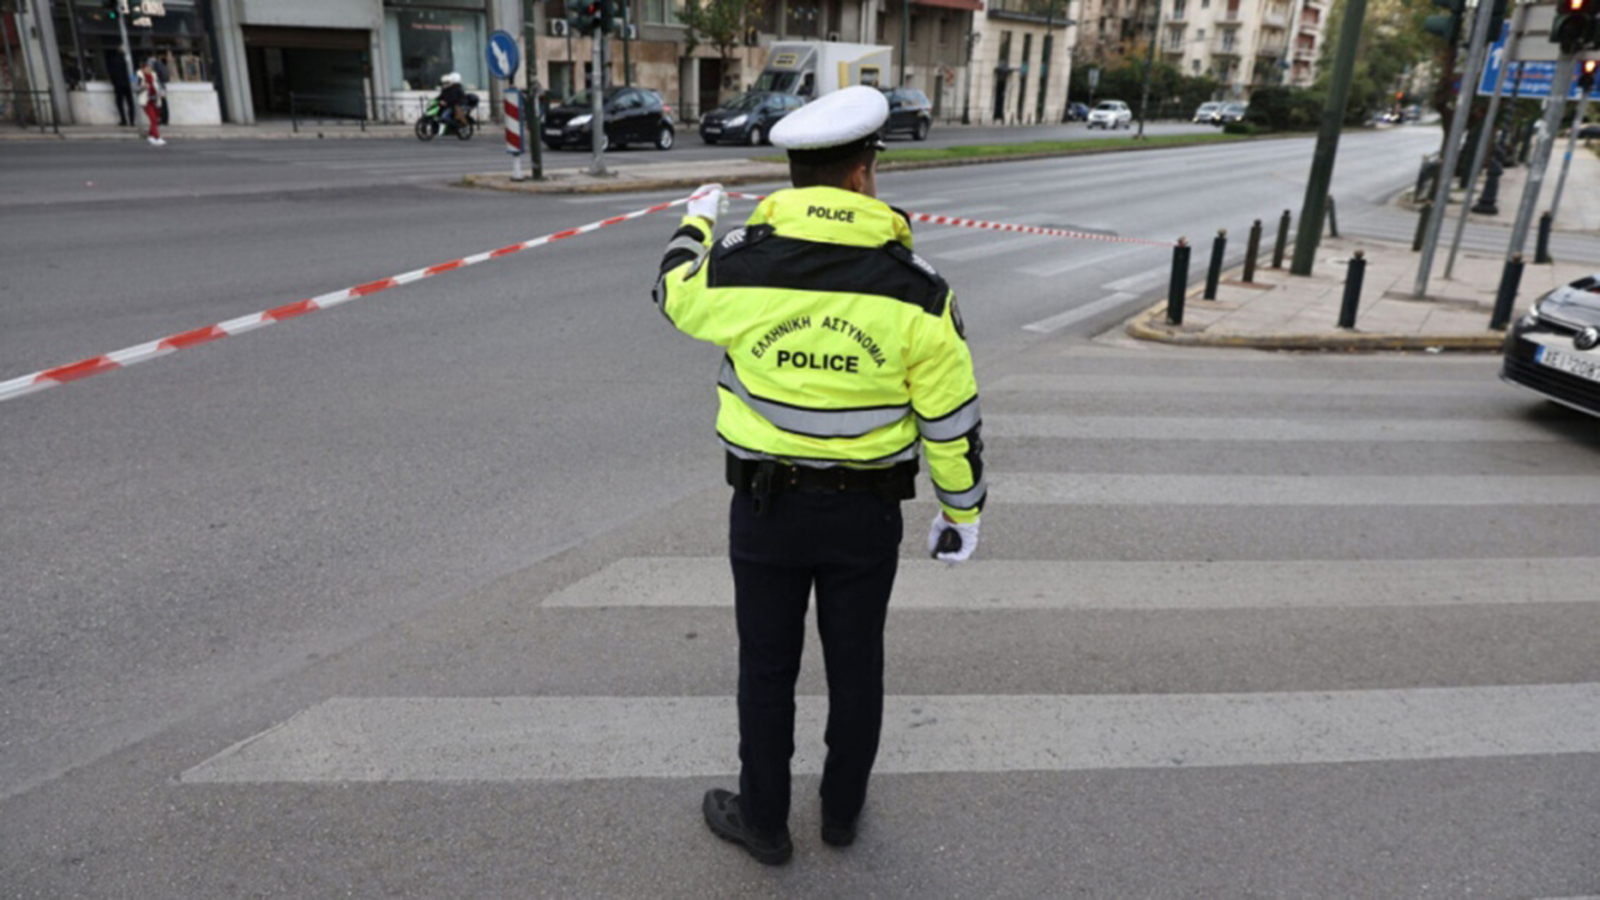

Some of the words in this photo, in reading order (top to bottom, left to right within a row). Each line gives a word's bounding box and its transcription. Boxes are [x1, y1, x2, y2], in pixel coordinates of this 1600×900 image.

[807, 205, 855, 223] POLICE
[751, 316, 811, 359] ΕΛΛΗΝΙΚΗ
[821, 315, 886, 368] ΑΣΤΥΝΟΜΙΑ
[777, 350, 859, 373] POLICE
